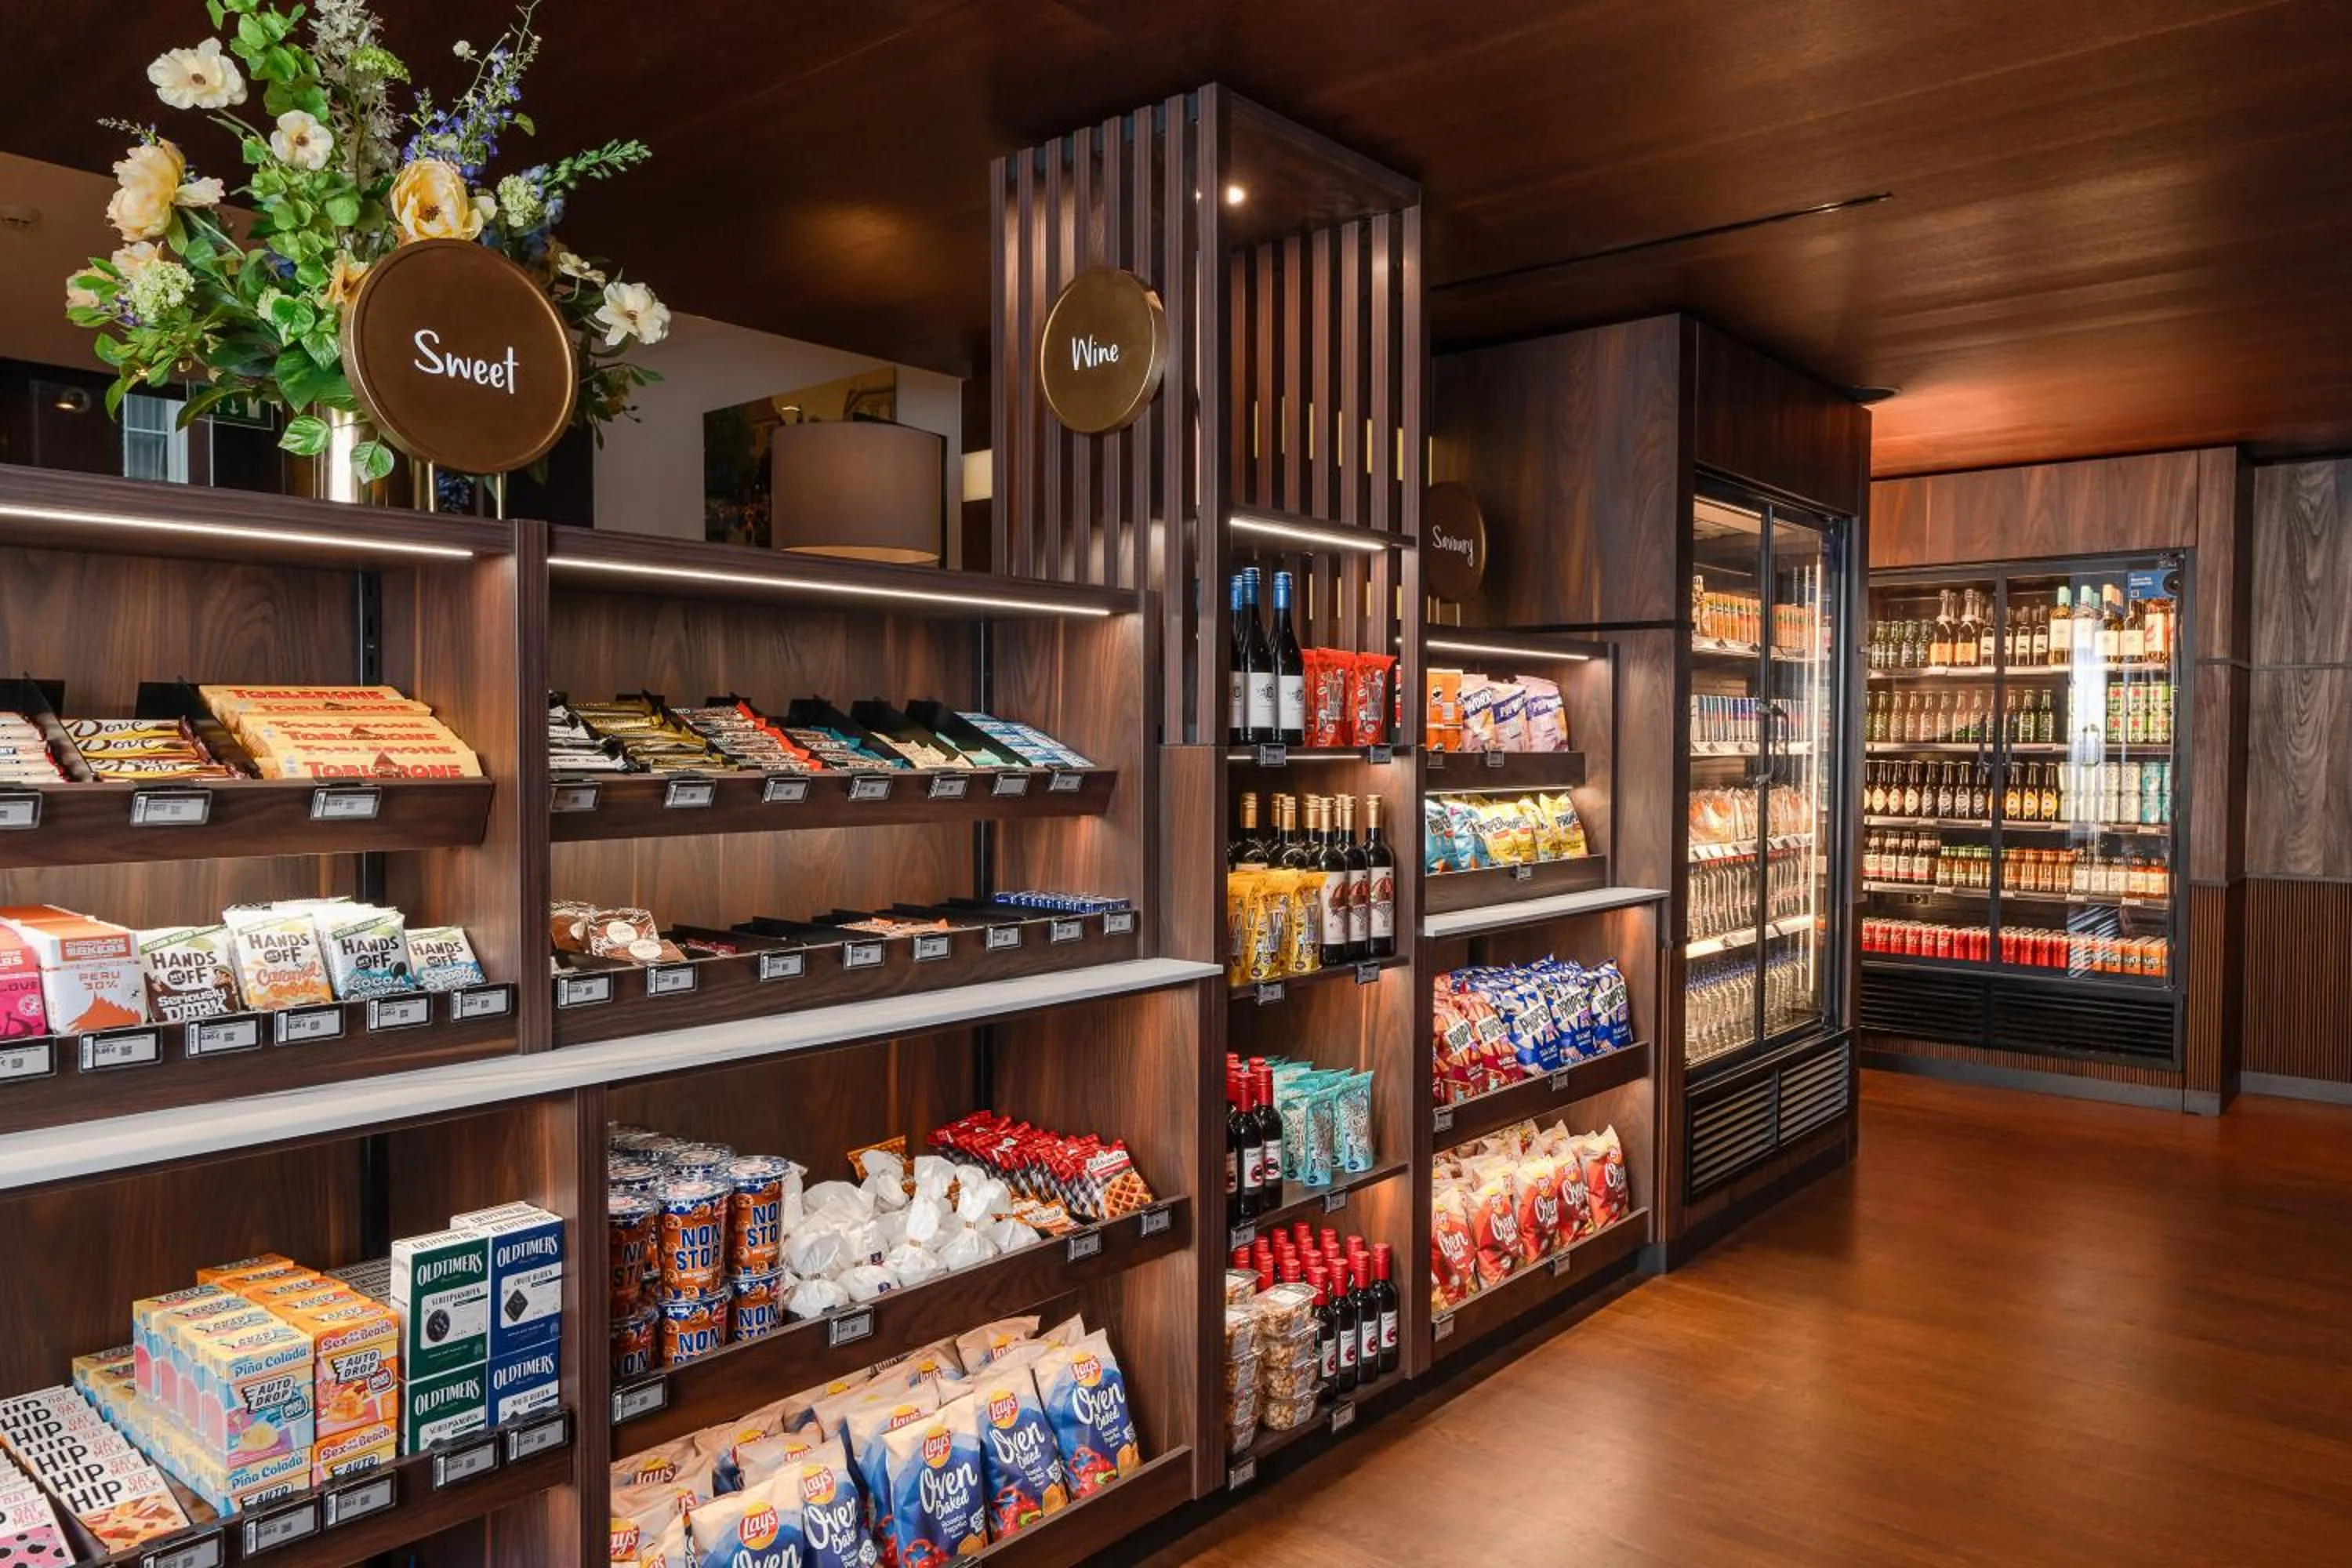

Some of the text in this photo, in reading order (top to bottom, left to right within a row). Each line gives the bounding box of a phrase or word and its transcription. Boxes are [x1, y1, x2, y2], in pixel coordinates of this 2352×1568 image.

[414, 329, 520, 394] Sweet
[1072, 335, 1120, 371] Wine
[281, 731, 440, 741] TOBLRONE
[303, 761, 465, 778] TOBLRONE
[247, 933, 310, 949] HANDS
[340, 936, 399, 956] HANDS
[408, 942, 464, 956] HANDS
[150, 951, 217, 970] HANDS
[79, 971, 120, 981] PERU
[162, 999, 233, 1022] DARK
[752, 1202, 778, 1225] NO
[747, 1222, 778, 1247] STO
[495, 1234, 557, 1268] OLDTIMERS
[416, 1251, 483, 1286] OLDTIMERS
[322, 1337, 347, 1352] Sex
[359, 1323, 392, 1341] Beach
[677, 1327, 721, 1354] NON
[265, 1346, 307, 1368] Colada
[345, 1351, 377, 1367] AUTO
[343, 1361, 376, 1377] DROP
[493, 1353, 555, 1390] OLDTIMERS
[256, 1388, 289, 1407] DROP
[258, 1378, 292, 1395] AUTO
[415, 1377, 481, 1416] OLDTIMERS
[1072, 1383, 1125, 1425] Oven
[321, 1446, 346, 1461] Sex
[358, 1428, 390, 1446] Beach
[989, 1421, 1045, 1465] Oven
[261, 1454, 303, 1474] Colada
[920, 1462, 978, 1514] Oven
[936, 1488, 970, 1520] Baked
